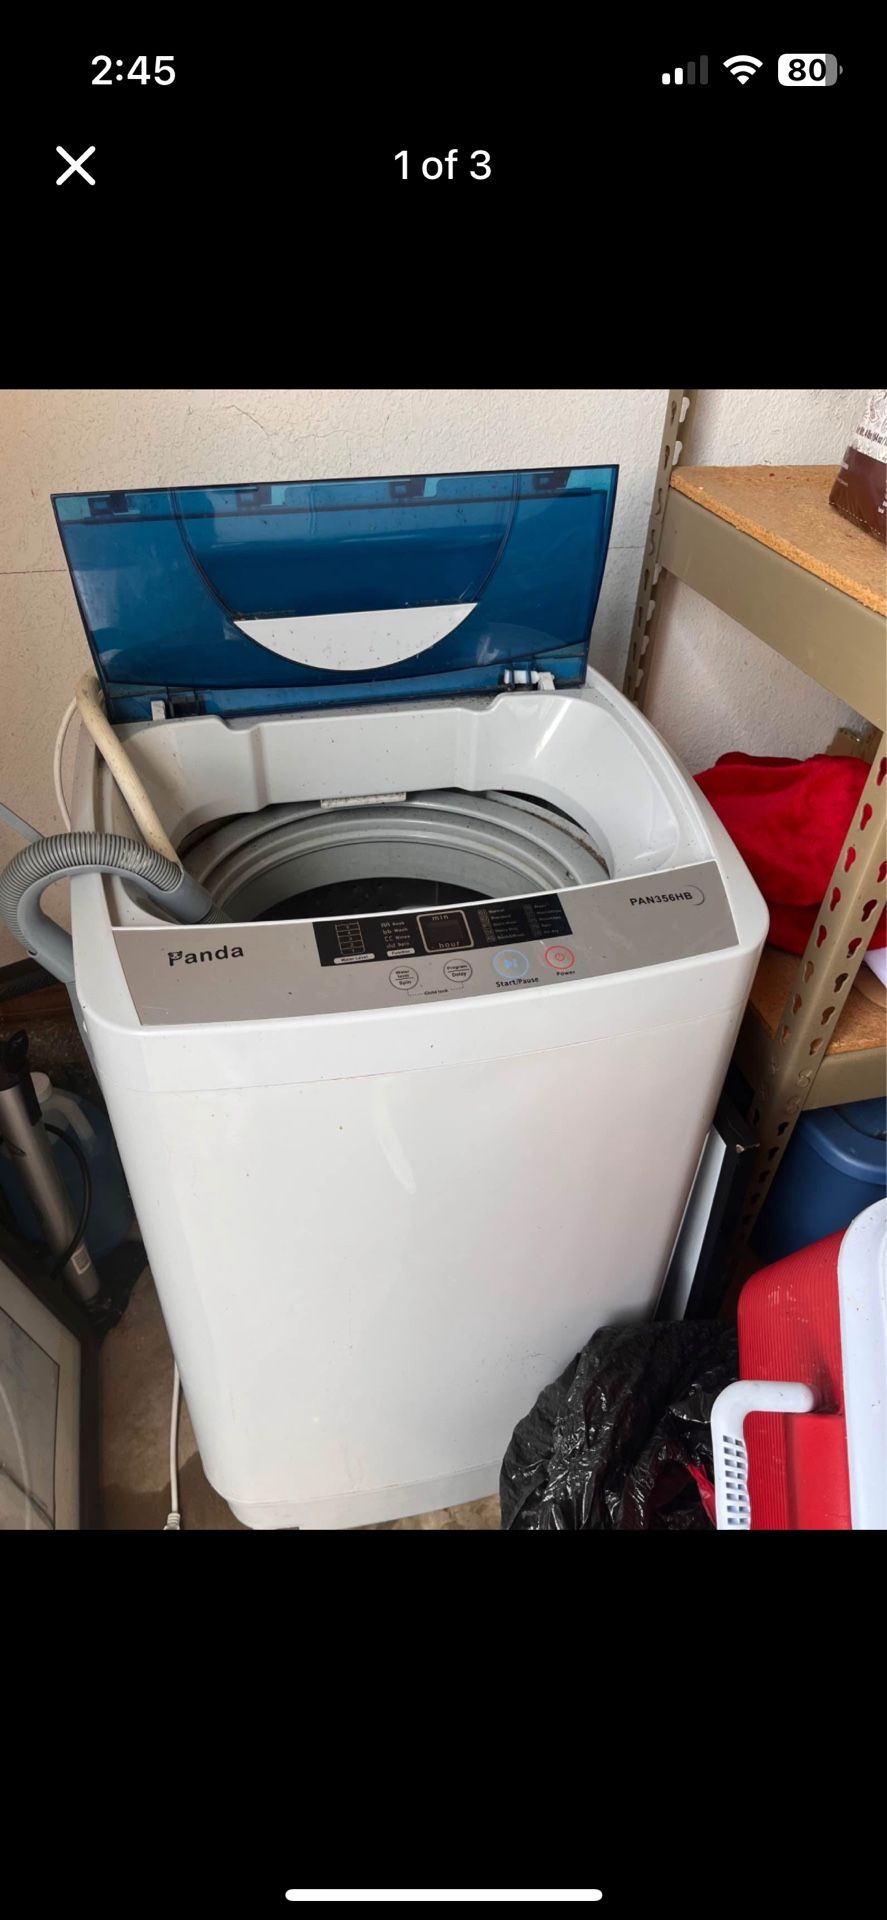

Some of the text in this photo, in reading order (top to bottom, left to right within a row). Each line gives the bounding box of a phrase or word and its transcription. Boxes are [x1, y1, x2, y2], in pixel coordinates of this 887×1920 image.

[629, 891, 693, 906] PAN356HB
[167, 945, 244, 967] Panda
[495, 977, 539, 988] Start/Pause
